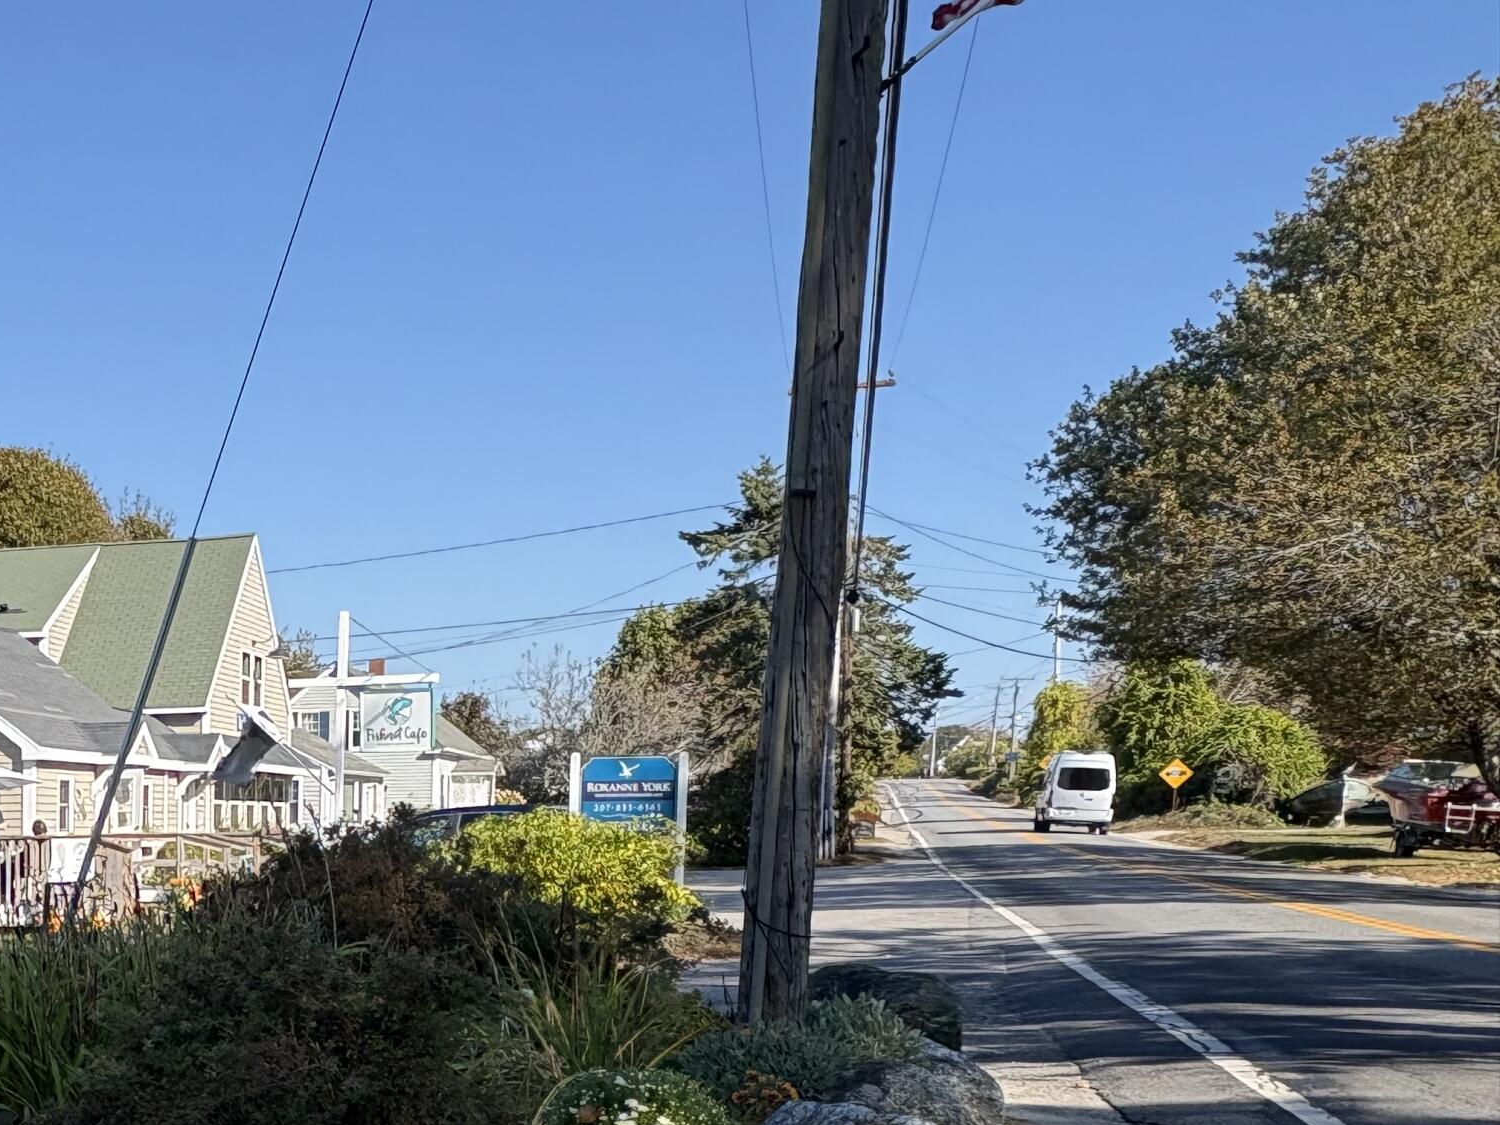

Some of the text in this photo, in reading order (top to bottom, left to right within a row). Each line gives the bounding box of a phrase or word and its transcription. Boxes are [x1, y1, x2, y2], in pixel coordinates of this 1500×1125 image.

[404, 726, 428, 744] Cafe
[587, 782, 672, 792] ROXANNE YORK
